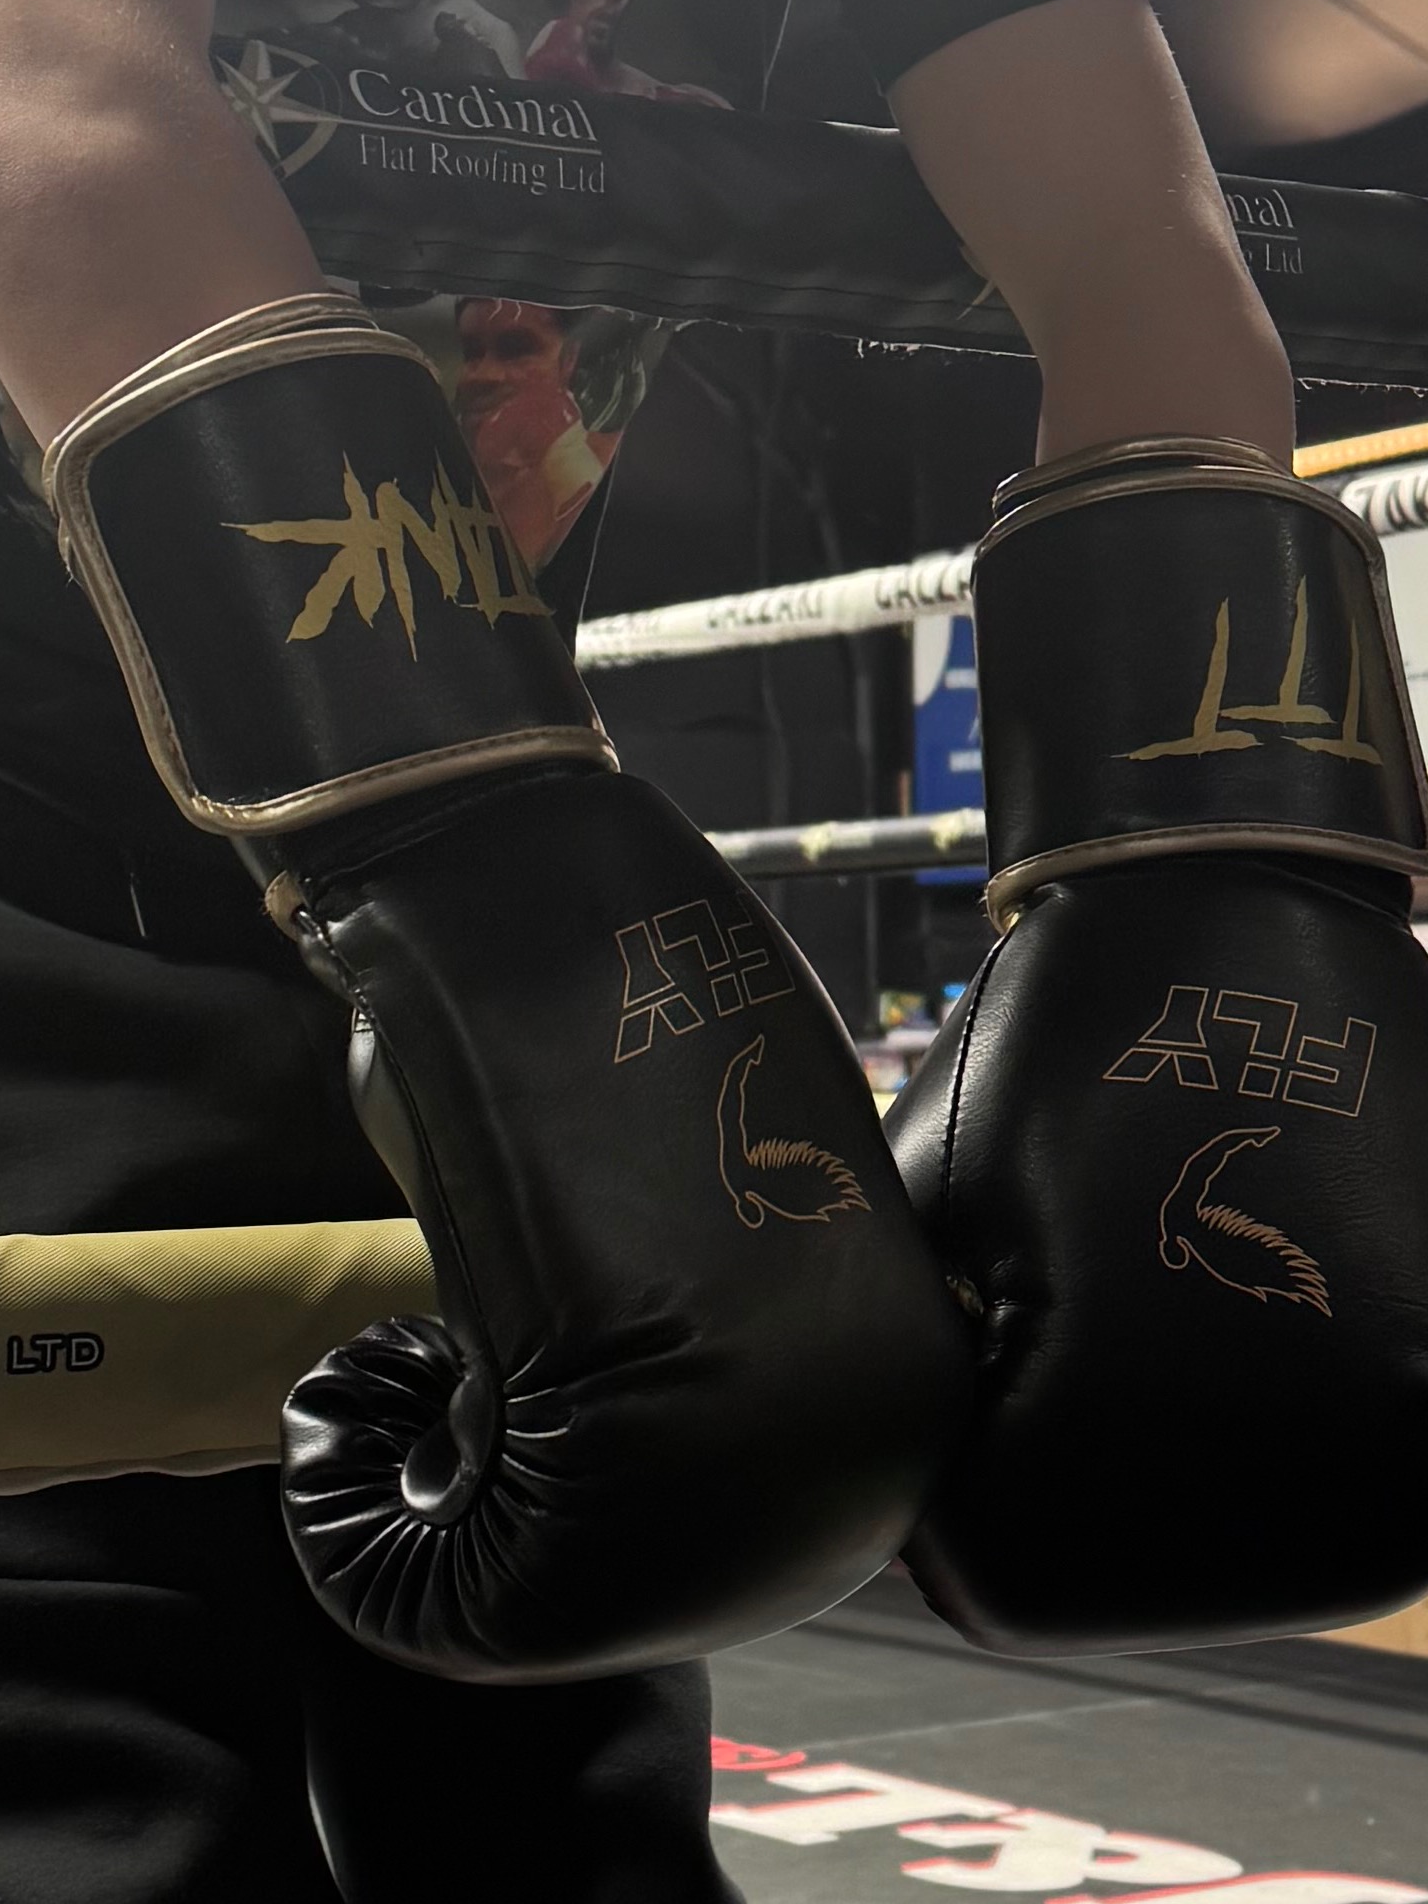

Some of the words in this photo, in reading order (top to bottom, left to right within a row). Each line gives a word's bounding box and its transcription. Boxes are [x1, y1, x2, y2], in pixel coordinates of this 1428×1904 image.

[348, 68, 598, 143] Cardinal
[359, 133, 417, 174] Flat
[430, 140, 549, 196] Roofing
[557, 156, 607, 195] Ltd
[1264, 242, 1305, 275] Ltd
[615, 889, 797, 1064] FLY
[1103, 985, 1377, 1117] FLY
[6, 1332, 105, 1375] LTD
